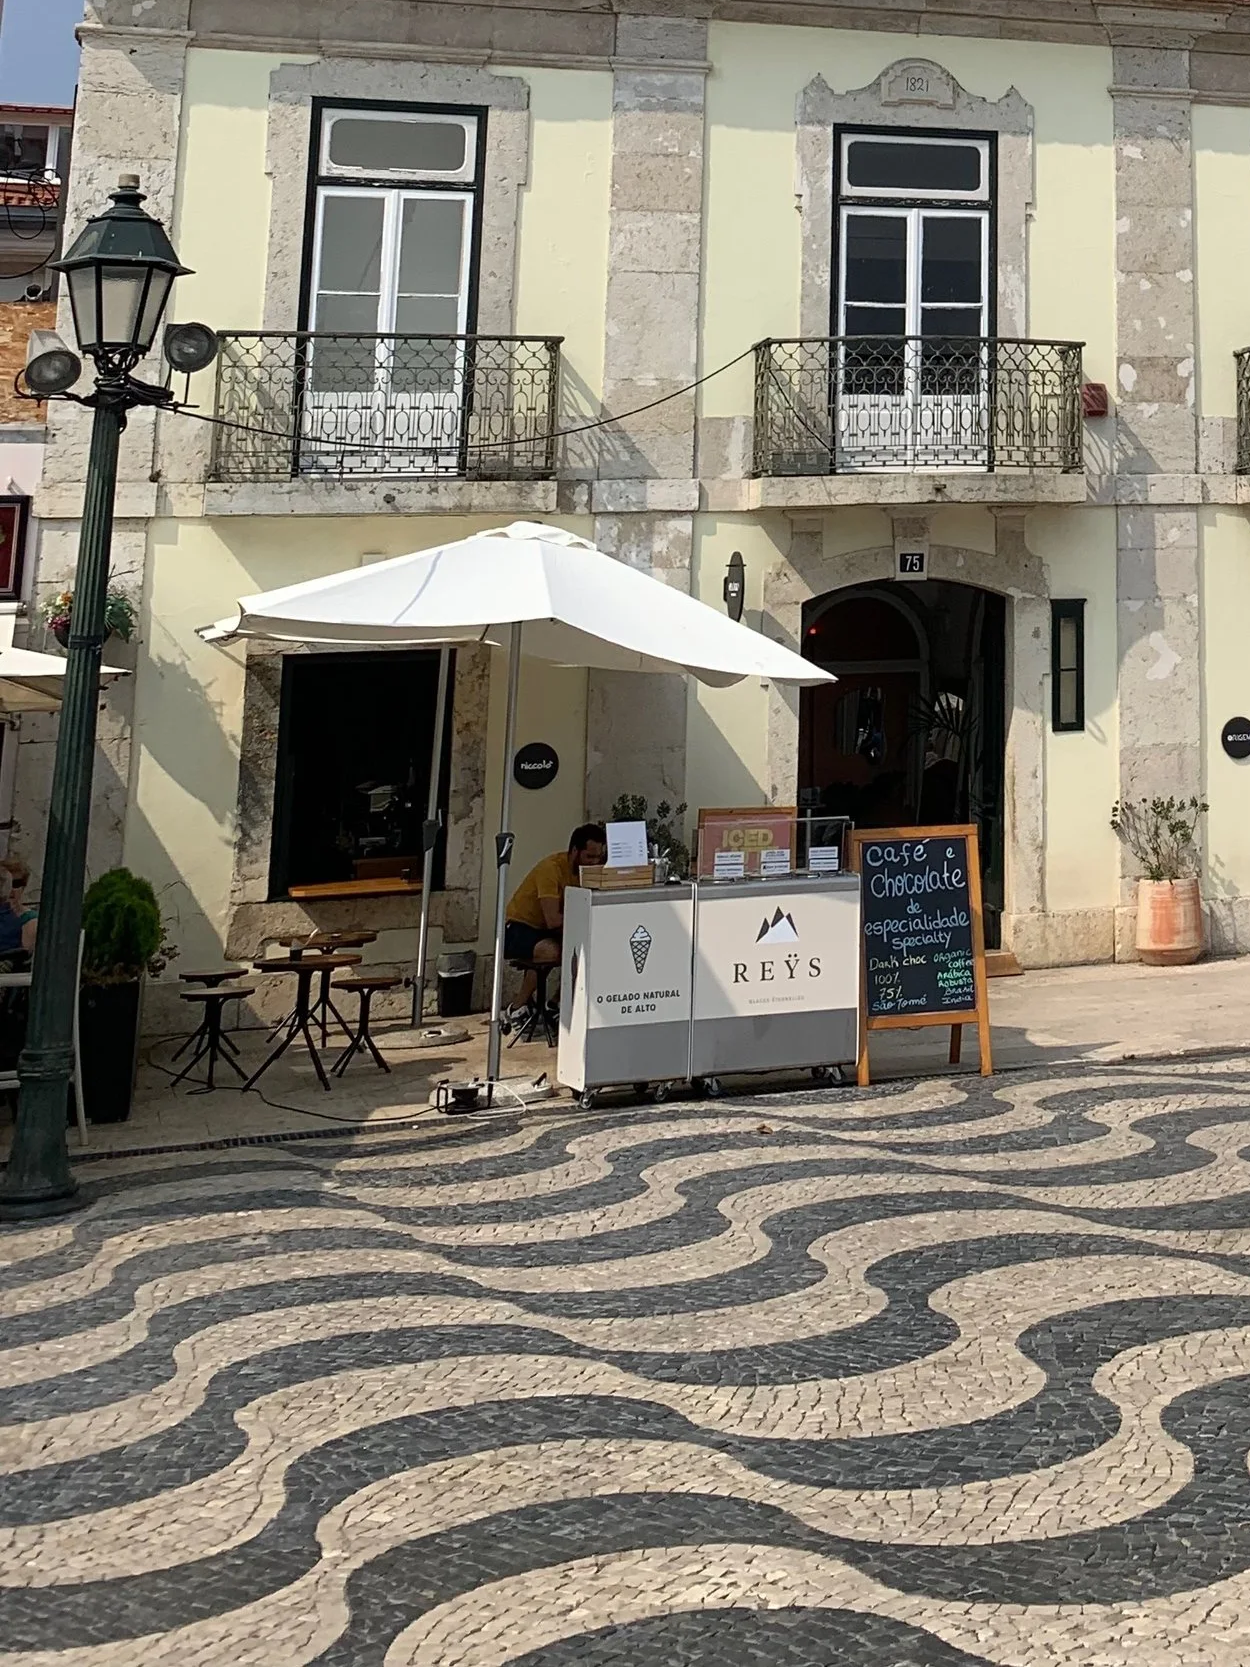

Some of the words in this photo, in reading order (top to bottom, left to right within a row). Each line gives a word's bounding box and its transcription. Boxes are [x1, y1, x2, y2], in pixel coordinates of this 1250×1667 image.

[906, 77, 929, 92] 1821
[905, 555, 920, 571] 75
[722, 828, 773, 848] ICED
[946, 847, 956, 859] e
[906, 898, 923, 914] de
[864, 906, 970, 943] especialidade
[902, 954, 927, 966] choc
[732, 953, 822, 984] REŸS
[875, 971, 900, 985] 100%
[597, 996, 604, 1004] O
[606, 993, 641, 1003] GELADO
[643, 989, 681, 1000] NATURAL
[879, 986, 903, 1000] 75%
[620, 1005, 632, 1014] DE
[635, 1003, 656, 1013] ALTO
